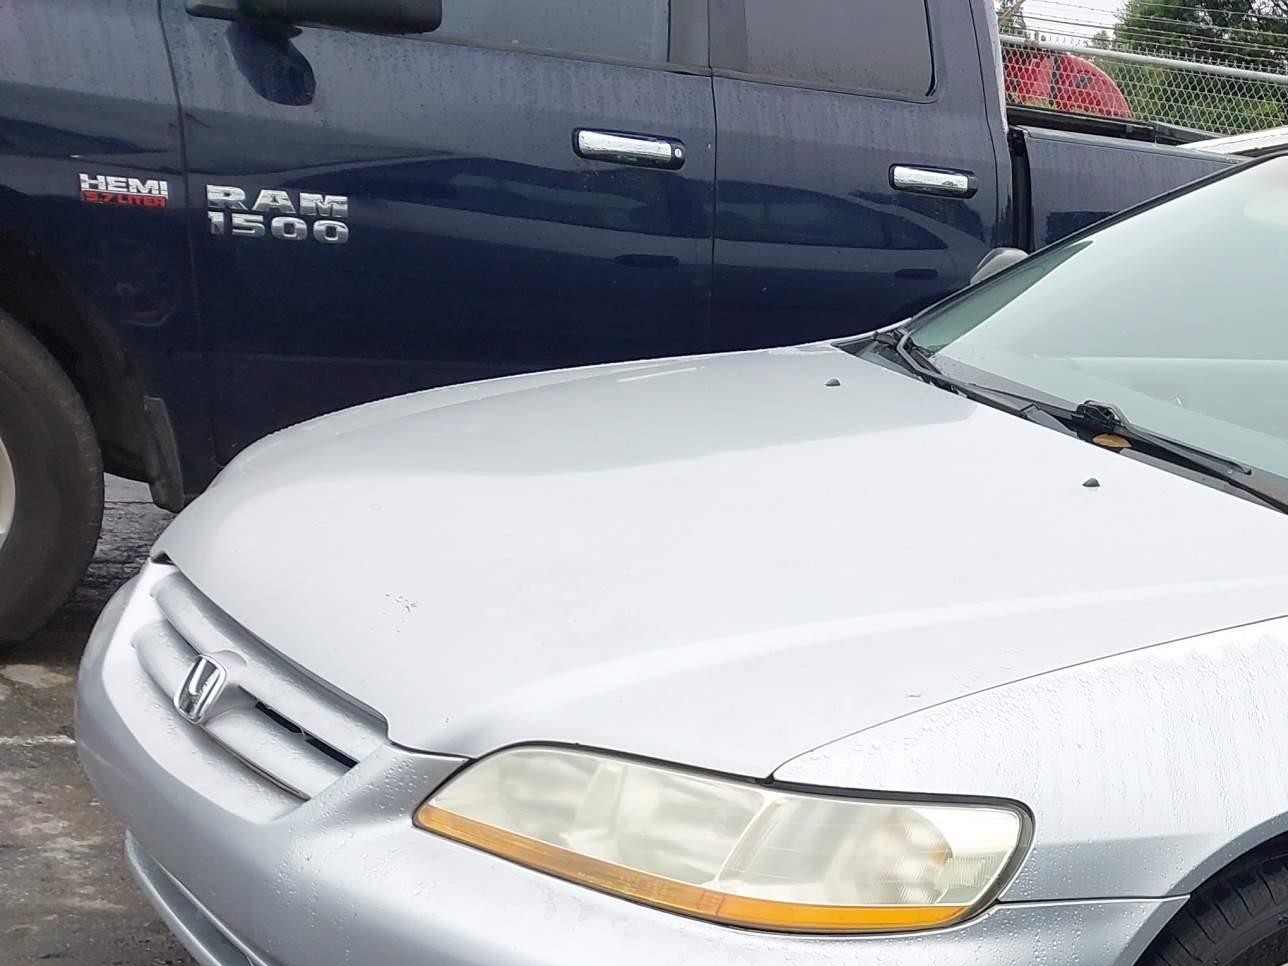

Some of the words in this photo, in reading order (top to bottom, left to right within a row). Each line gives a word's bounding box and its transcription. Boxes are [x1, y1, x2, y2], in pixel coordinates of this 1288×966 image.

[79, 173, 168, 195] HEMI
[206, 184, 348, 217] RAM
[207, 211, 349, 243] 1500
